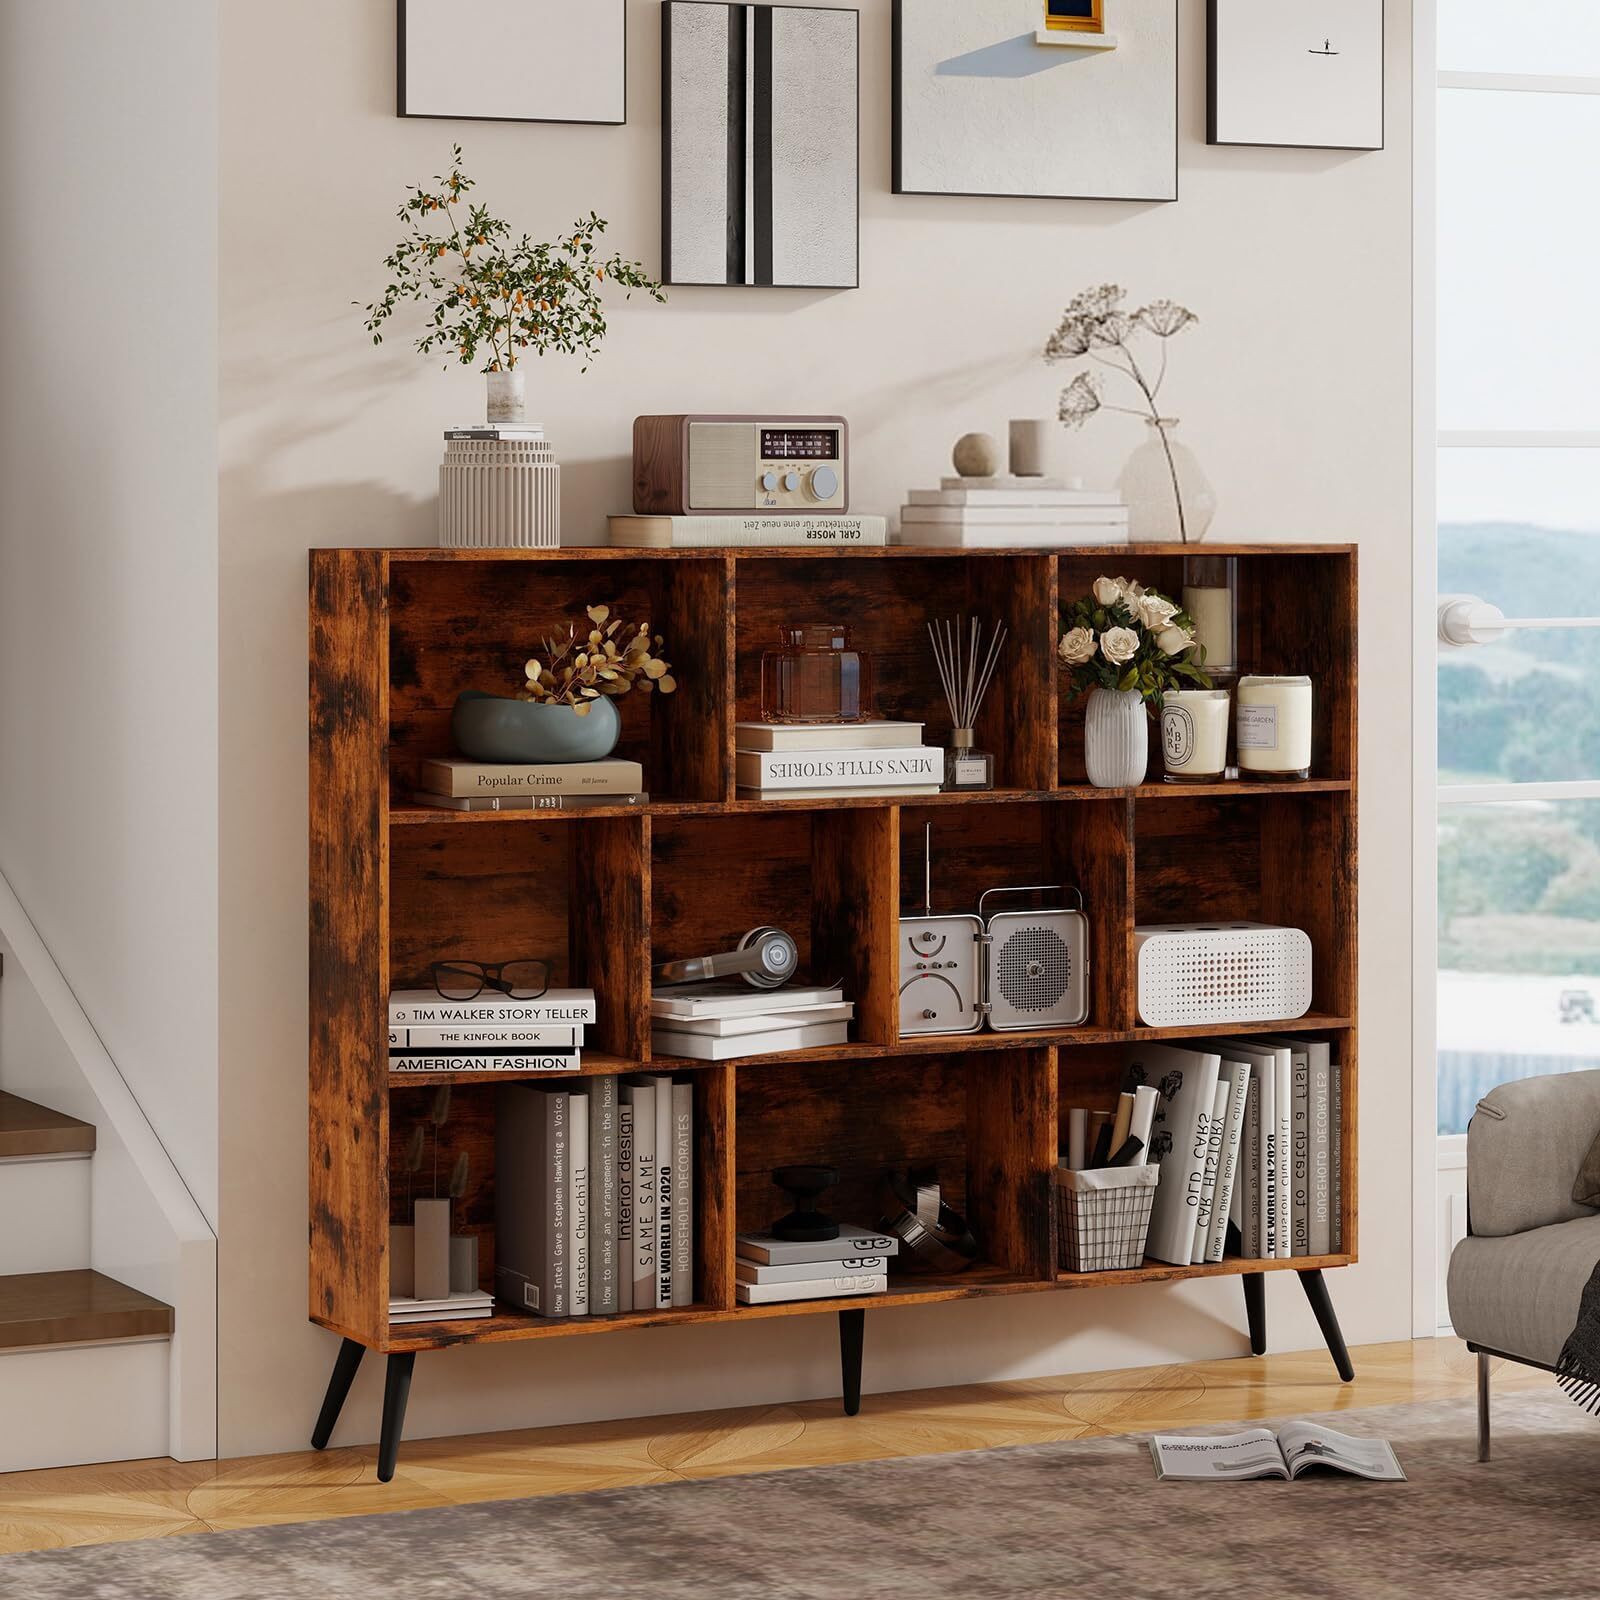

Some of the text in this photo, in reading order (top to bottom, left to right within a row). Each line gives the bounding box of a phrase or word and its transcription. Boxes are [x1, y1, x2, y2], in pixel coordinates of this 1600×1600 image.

[744, 521, 759, 529] Zeit
[802, 521, 814, 529] für
[817, 521, 861, 529] Architektur
[770, 759, 933, 778] MEN'S STYLE STORIES
[478, 775, 562, 788] Popular Crime
[413, 1009, 588, 1020] TIM WALKER STORY TELLER
[464, 1033, 508, 1041] KINFOLK
[396, 1058, 567, 1070] AMERICAN FASHION
[554, 1097, 562, 1126] Voice
[554, 1142, 564, 1183] Hawking
[617, 1111, 633, 1241] Interior design
[1267, 1170, 1275, 1182] IN
[602, 1079, 613, 1304] How to make an arrangement in the house
[678, 1114, 688, 1272] HOUSEHOLD DECORATES
[554, 1187, 564, 1227] Stephen
[639, 1155, 653, 1265] SAME SAME
[554, 1234, 562, 1256] Gave
[575, 1168, 586, 1305] Winston Churchill
[660, 1167, 671, 1302] THE WORLD IN 2020
[1267, 1231, 1275, 1254] THE
[554, 1261, 562, 1289] Intel
